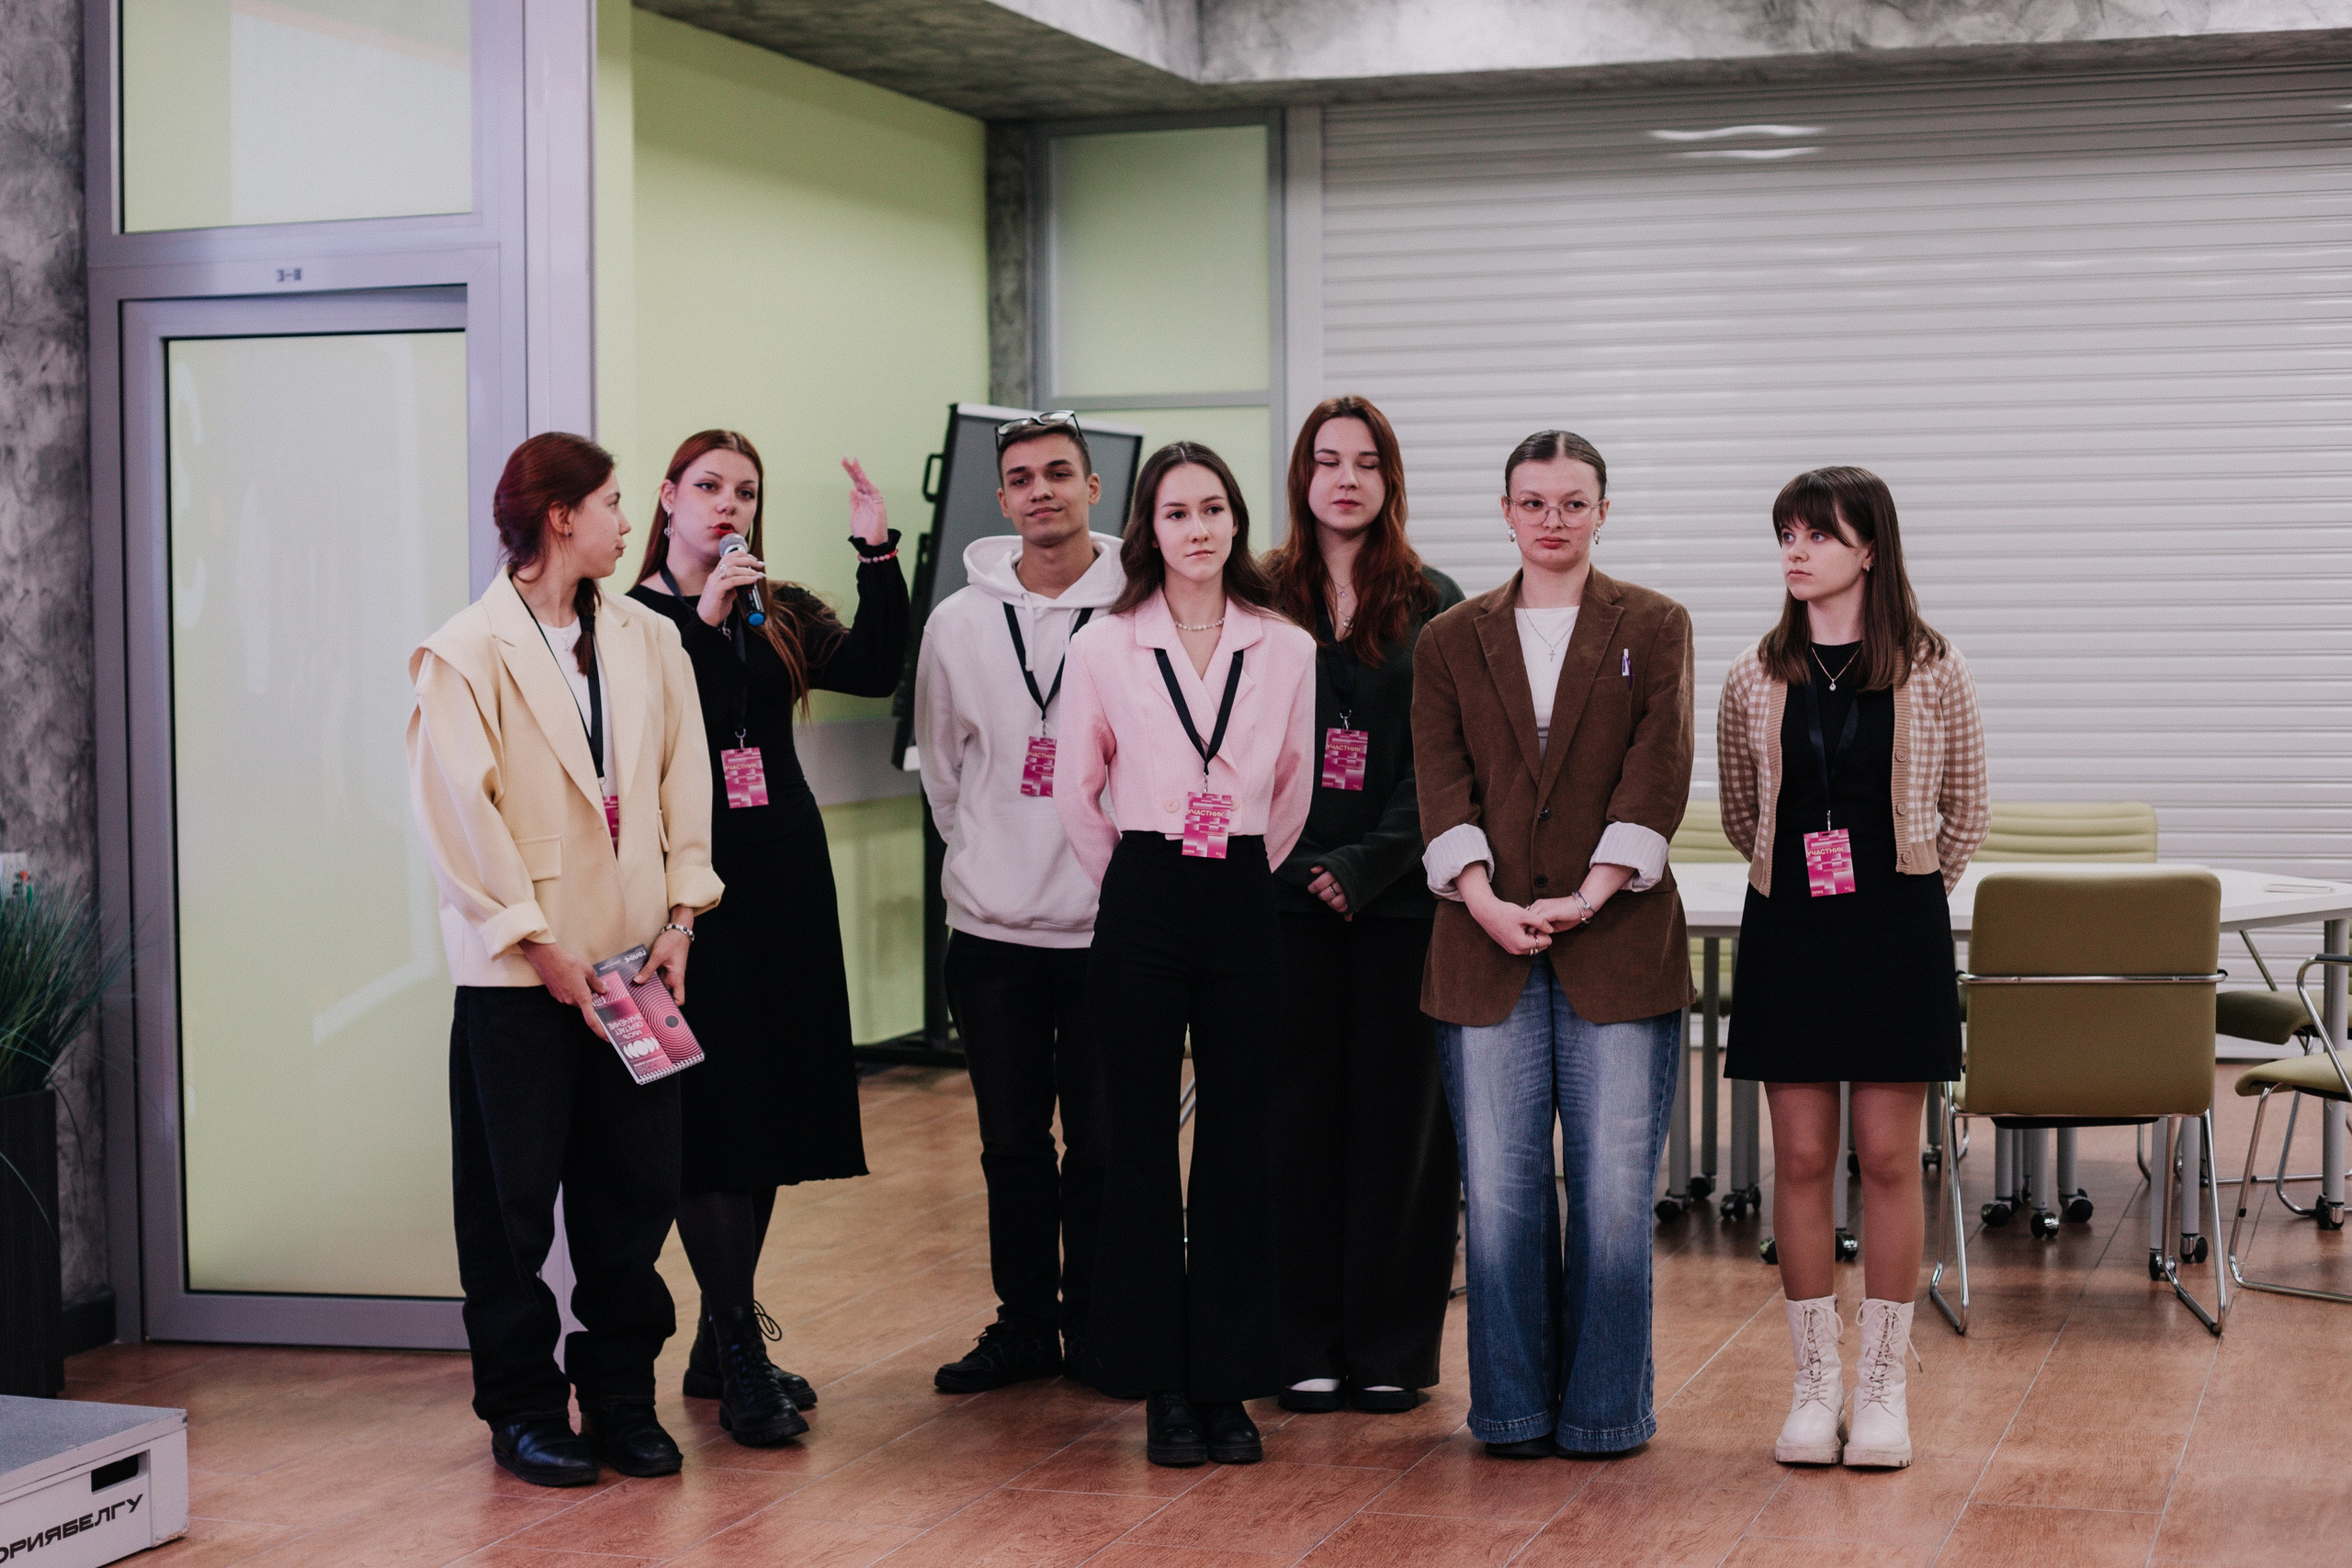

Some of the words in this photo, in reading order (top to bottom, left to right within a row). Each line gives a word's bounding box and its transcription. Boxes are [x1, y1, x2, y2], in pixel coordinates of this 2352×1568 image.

[1327, 744, 1361, 752] УЧАСТНИК
[1188, 809, 1224, 818] УЧАСТНИК
[1807, 847, 1844, 856] УЧАСТНИК
[606, 1013, 643, 1031] ЗНАЧЕНИЕ
[616, 1021, 644, 1036] ОБРЕТАЕТ
